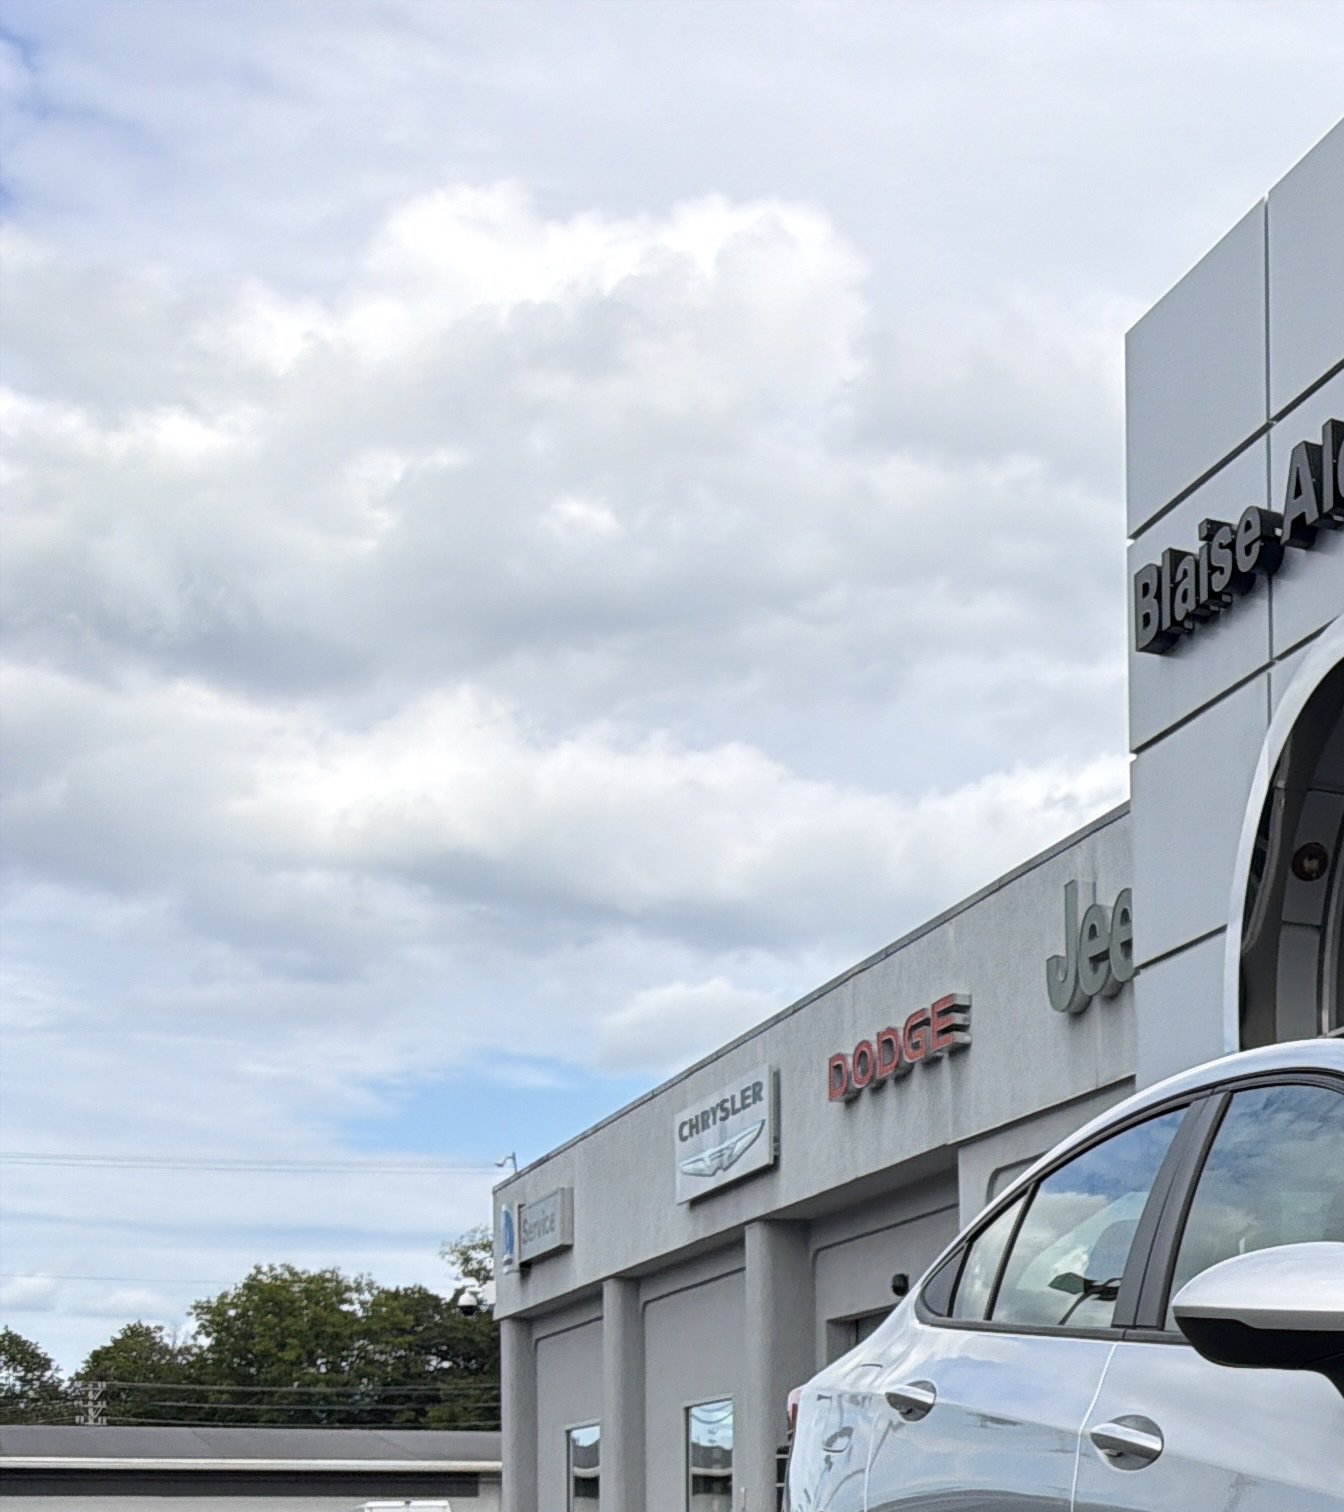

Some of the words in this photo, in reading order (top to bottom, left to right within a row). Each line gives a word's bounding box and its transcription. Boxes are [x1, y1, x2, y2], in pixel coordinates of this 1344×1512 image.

[1134, 505, 1270, 653] Blaise
[1046, 879, 1134, 1013] Jee
[828, 993, 967, 1102] DODGE
[678, 1081, 764, 1142] CHRYSLER
[521, 1209, 557, 1246] Service
